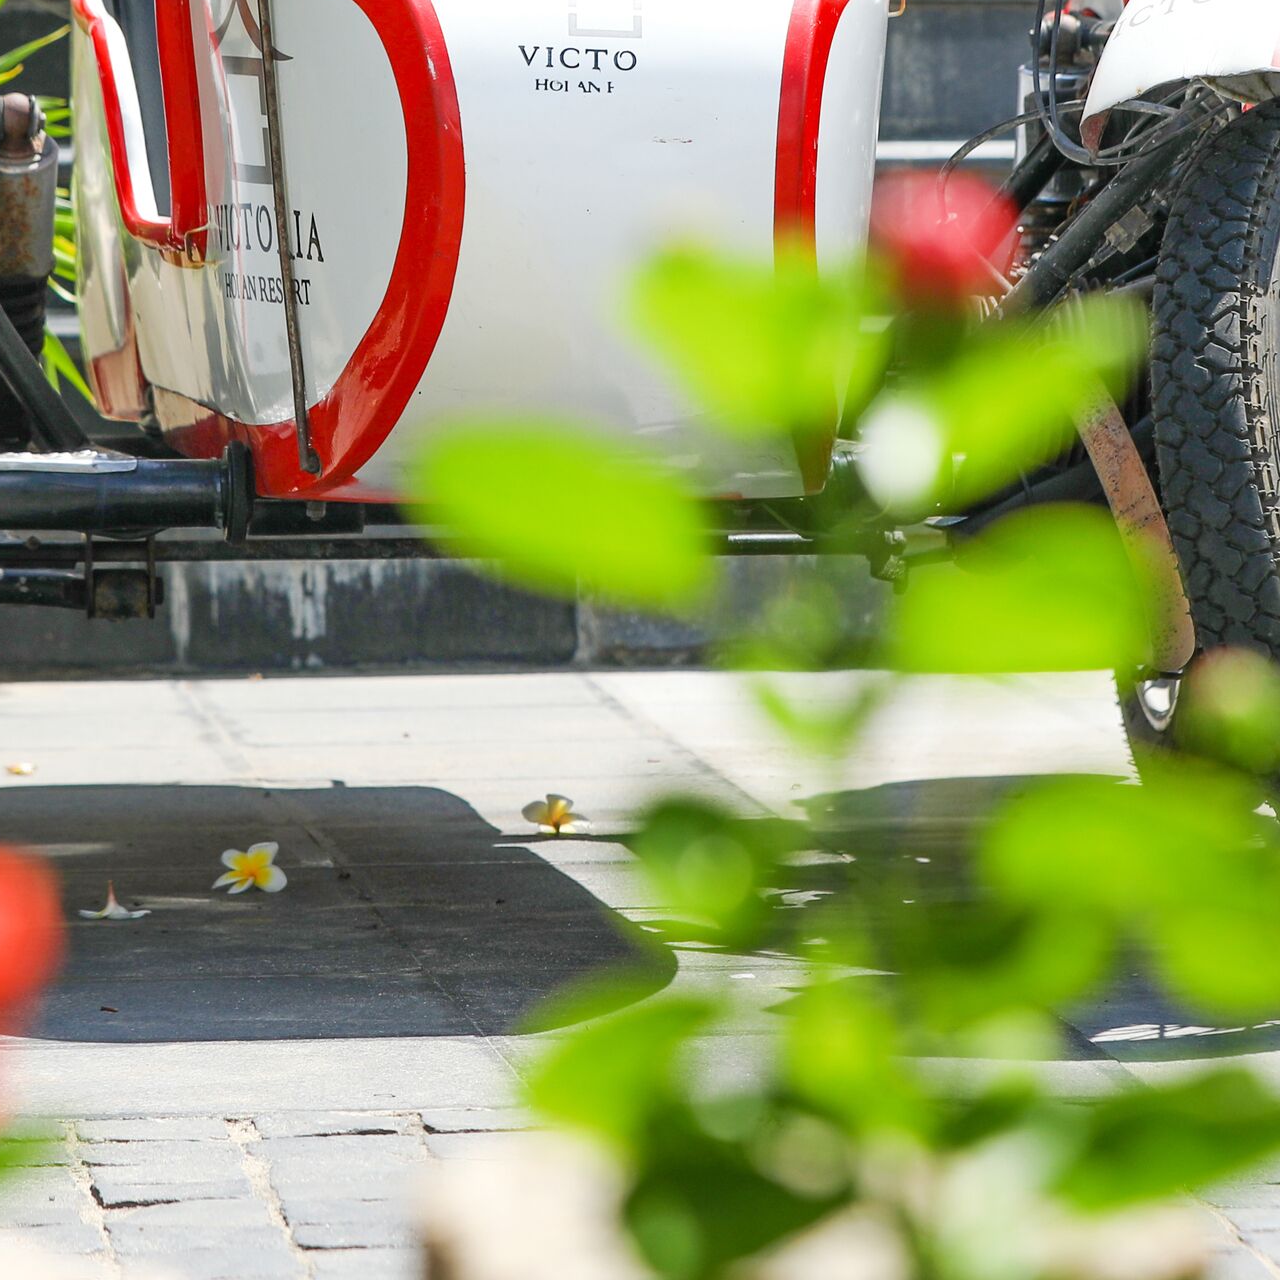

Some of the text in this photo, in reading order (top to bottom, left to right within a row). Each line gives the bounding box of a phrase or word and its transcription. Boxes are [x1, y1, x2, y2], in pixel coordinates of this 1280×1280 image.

[518, 45, 637, 72] VICTO
[216, 202, 325, 263] VICTOIA
[258, 276, 311, 305] RESRT
